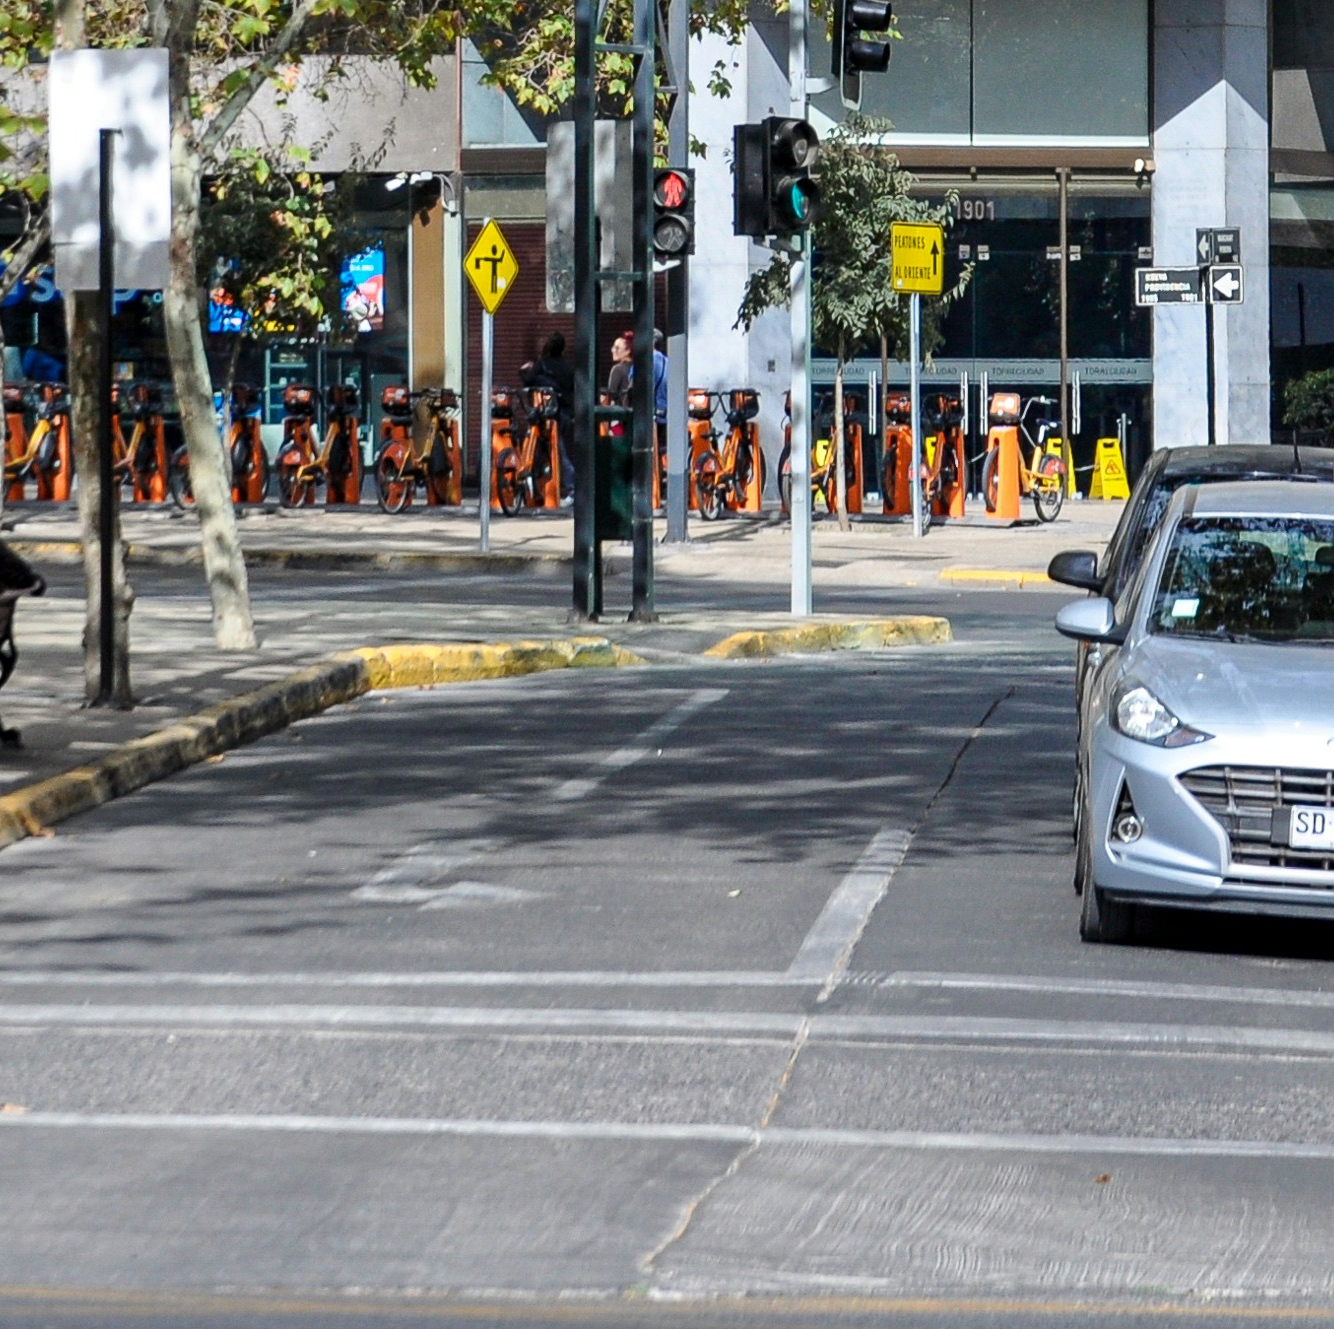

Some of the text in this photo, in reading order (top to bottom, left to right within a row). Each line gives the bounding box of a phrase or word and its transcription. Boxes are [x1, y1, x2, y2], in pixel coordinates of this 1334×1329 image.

[956, 200, 995, 221] 1901
[894, 235, 926, 249] PEATONES
[895, 266, 931, 280] AL ORIENTE
